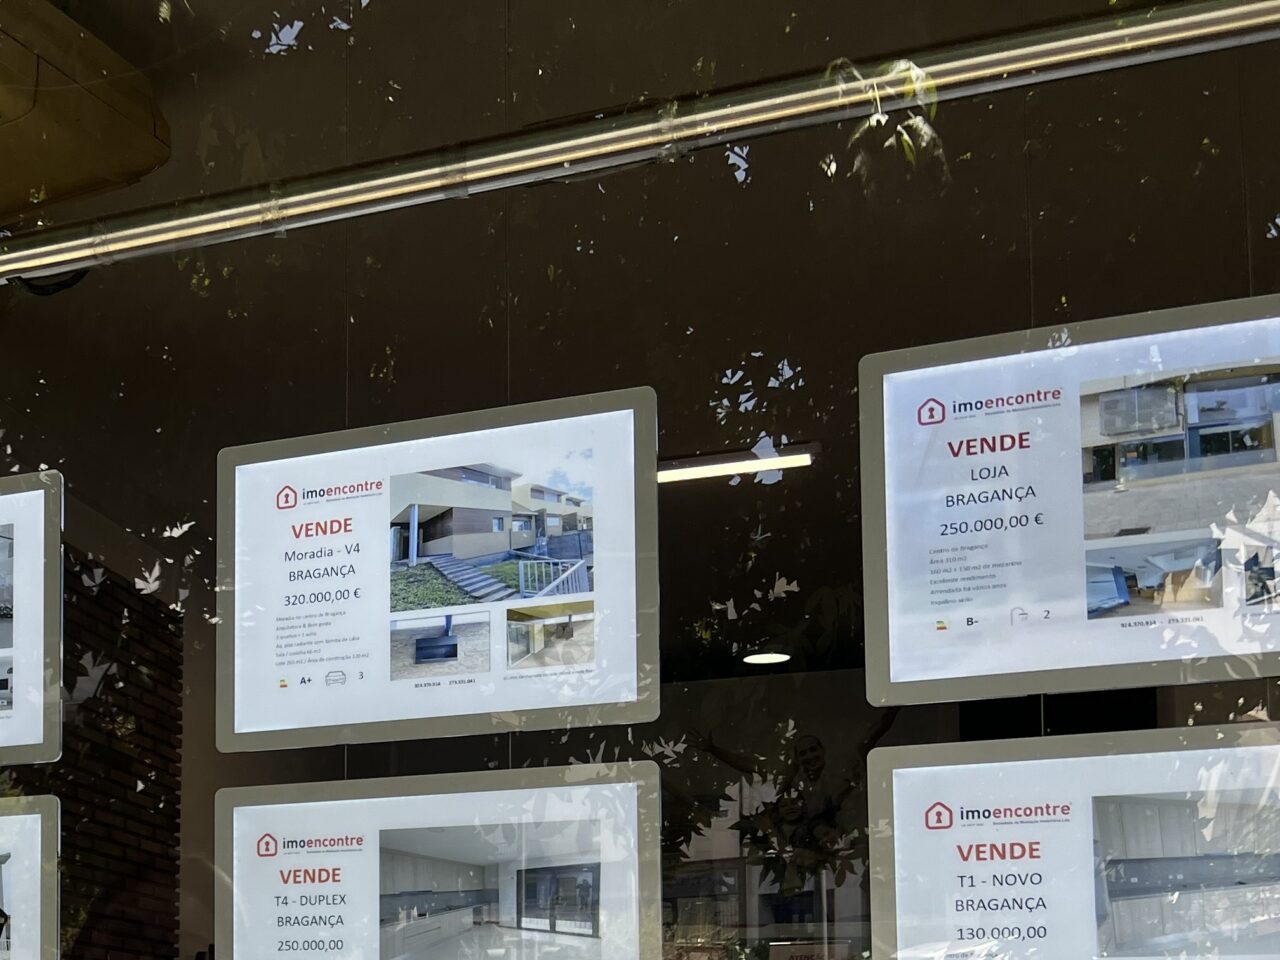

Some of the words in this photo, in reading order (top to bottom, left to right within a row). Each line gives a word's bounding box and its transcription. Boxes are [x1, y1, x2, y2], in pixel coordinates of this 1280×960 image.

[953, 389, 1061, 413] imoencontre
[948, 432, 1030, 458] VENDE
[971, 465, 1009, 481] LOJA
[302, 480, 383, 500] imoencontre
[946, 485, 1036, 508] BRAGANÇA
[292, 518, 352, 539] VENDE
[940, 514, 1029, 536] 250.000,00
[1034, 513, 1044, 525] €
[284, 547, 333, 562] Moradia
[345, 543, 360, 555] V4
[289, 564, 356, 582] BRAGANÇA
[284, 589, 350, 607] 320.000,00
[354, 588, 361, 598] €
[1043, 610, 1050, 619] 2
[300, 677, 312, 685] A+
[960, 803, 1071, 820] imoencontre
[283, 835, 364, 849] imoencontre
[957, 841, 1041, 862] VENDE
[280, 868, 341, 884] VENDE
[957, 875, 976, 888] T1
[992, 873, 1043, 887] NOVO
[274, 896, 289, 907] T4
[300, 894, 347, 906] DUPLEX
[955, 897, 1047, 913] BRAGANÇA
[277, 915, 345, 928] BRAGANÇA
[957, 926, 1047, 941] 130.000,00
[277, 940, 344, 952] 250.000,00
